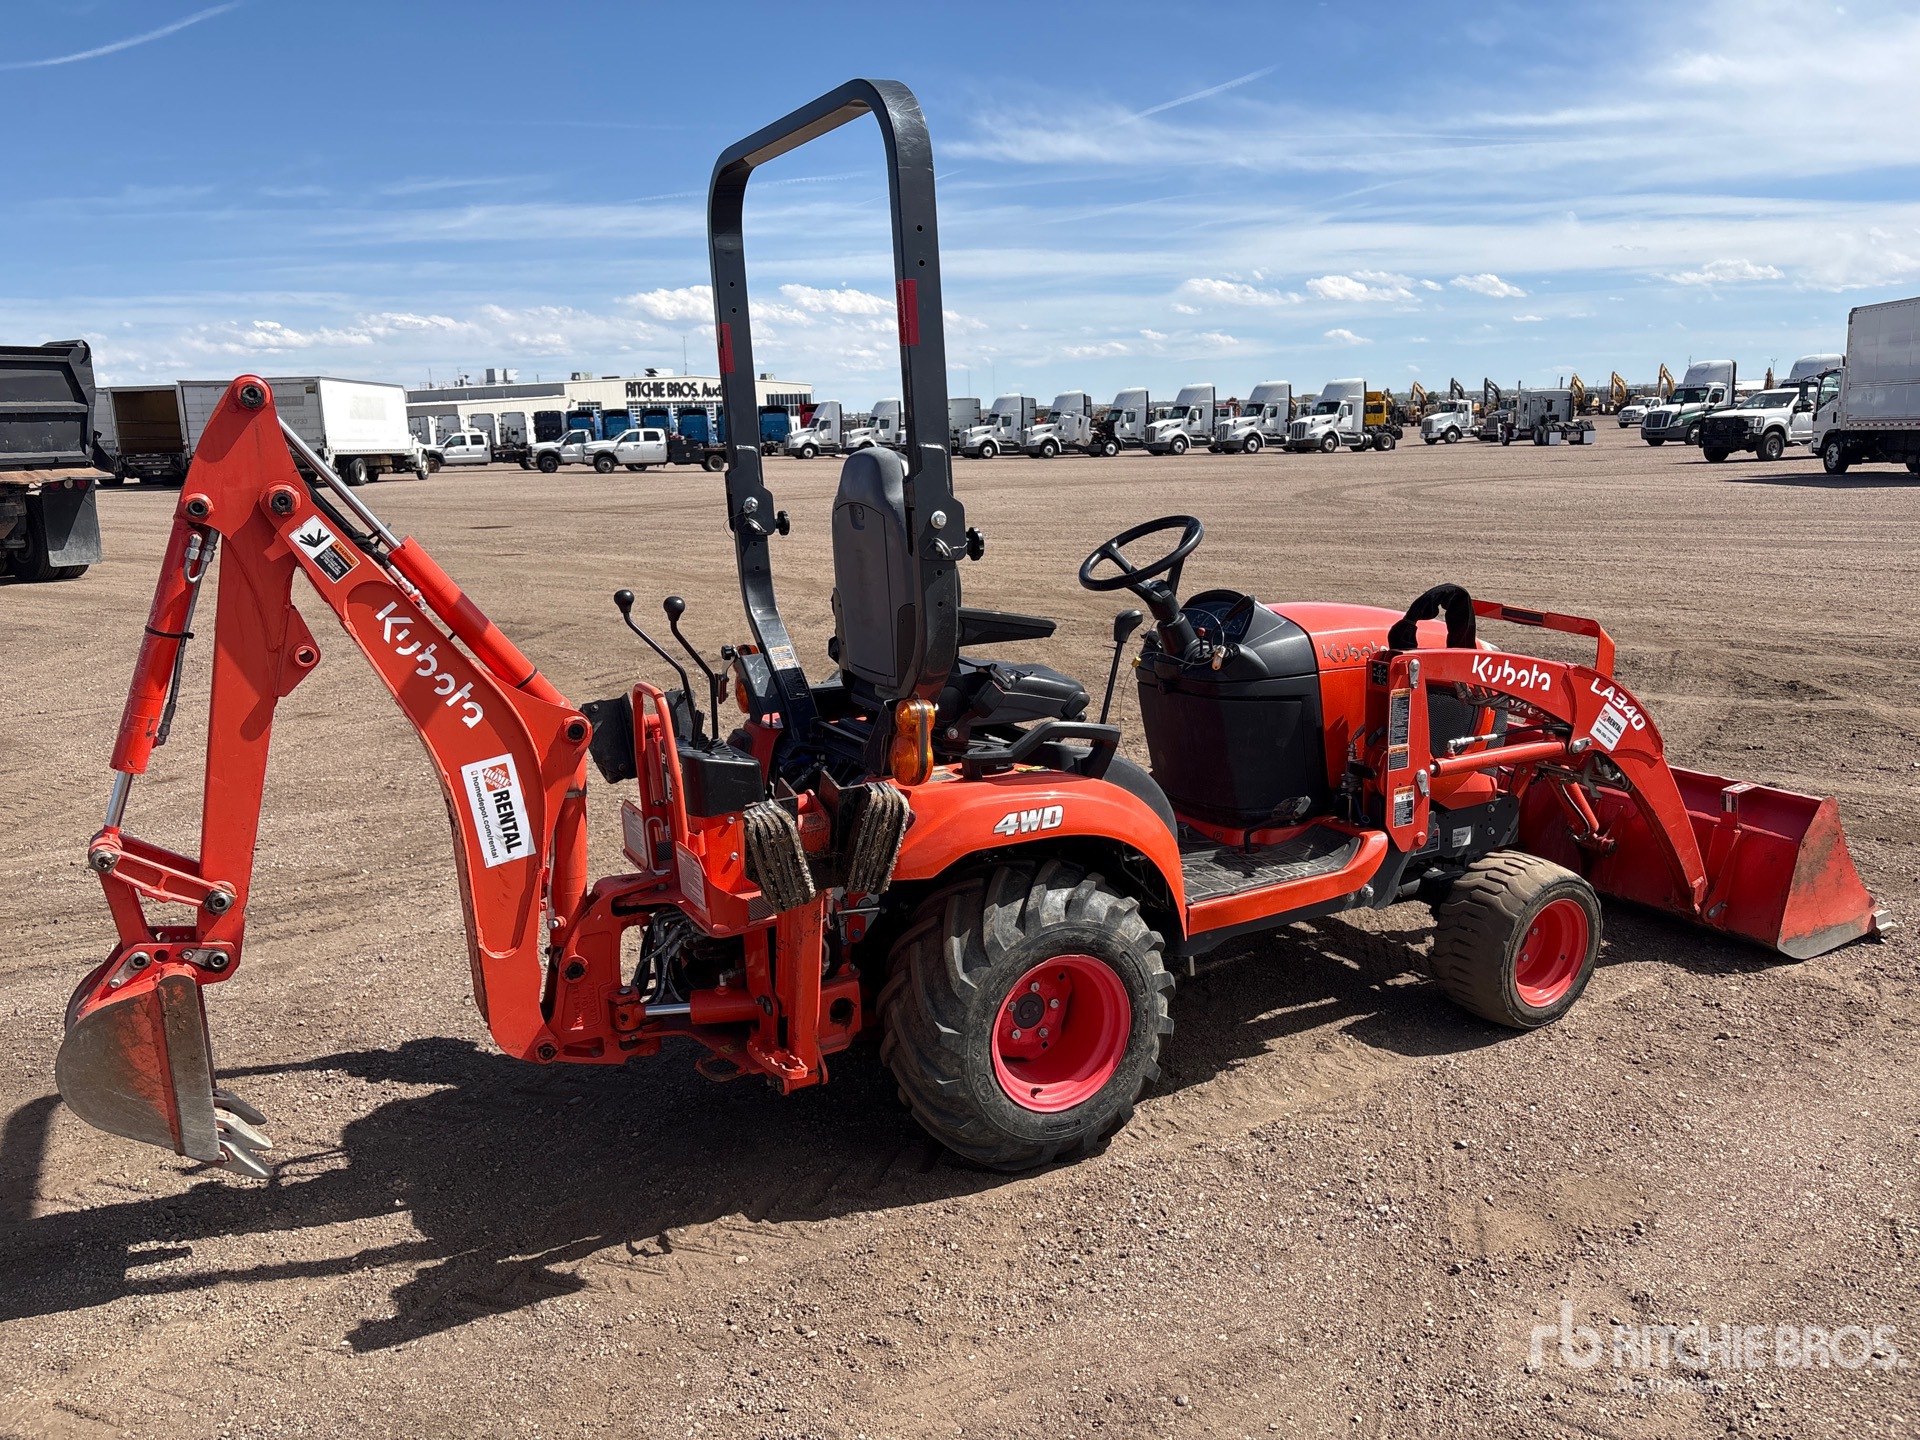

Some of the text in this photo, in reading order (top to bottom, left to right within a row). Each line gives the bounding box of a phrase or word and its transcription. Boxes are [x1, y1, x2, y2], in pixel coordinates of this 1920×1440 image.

[625, 382, 666, 398] RITCHIE
[667, 382, 700, 398] BROS.
[375, 601, 484, 729] Kubota
[1471, 655, 1551, 691] Kubota
[1590, 677, 1646, 731] LA340
[1606, 715, 1623, 735] RENTAL
[472, 776, 499, 859] homedepot.com/rental
[493, 789, 523, 854] RENTAL
[993, 804, 1064, 837] 4WD
